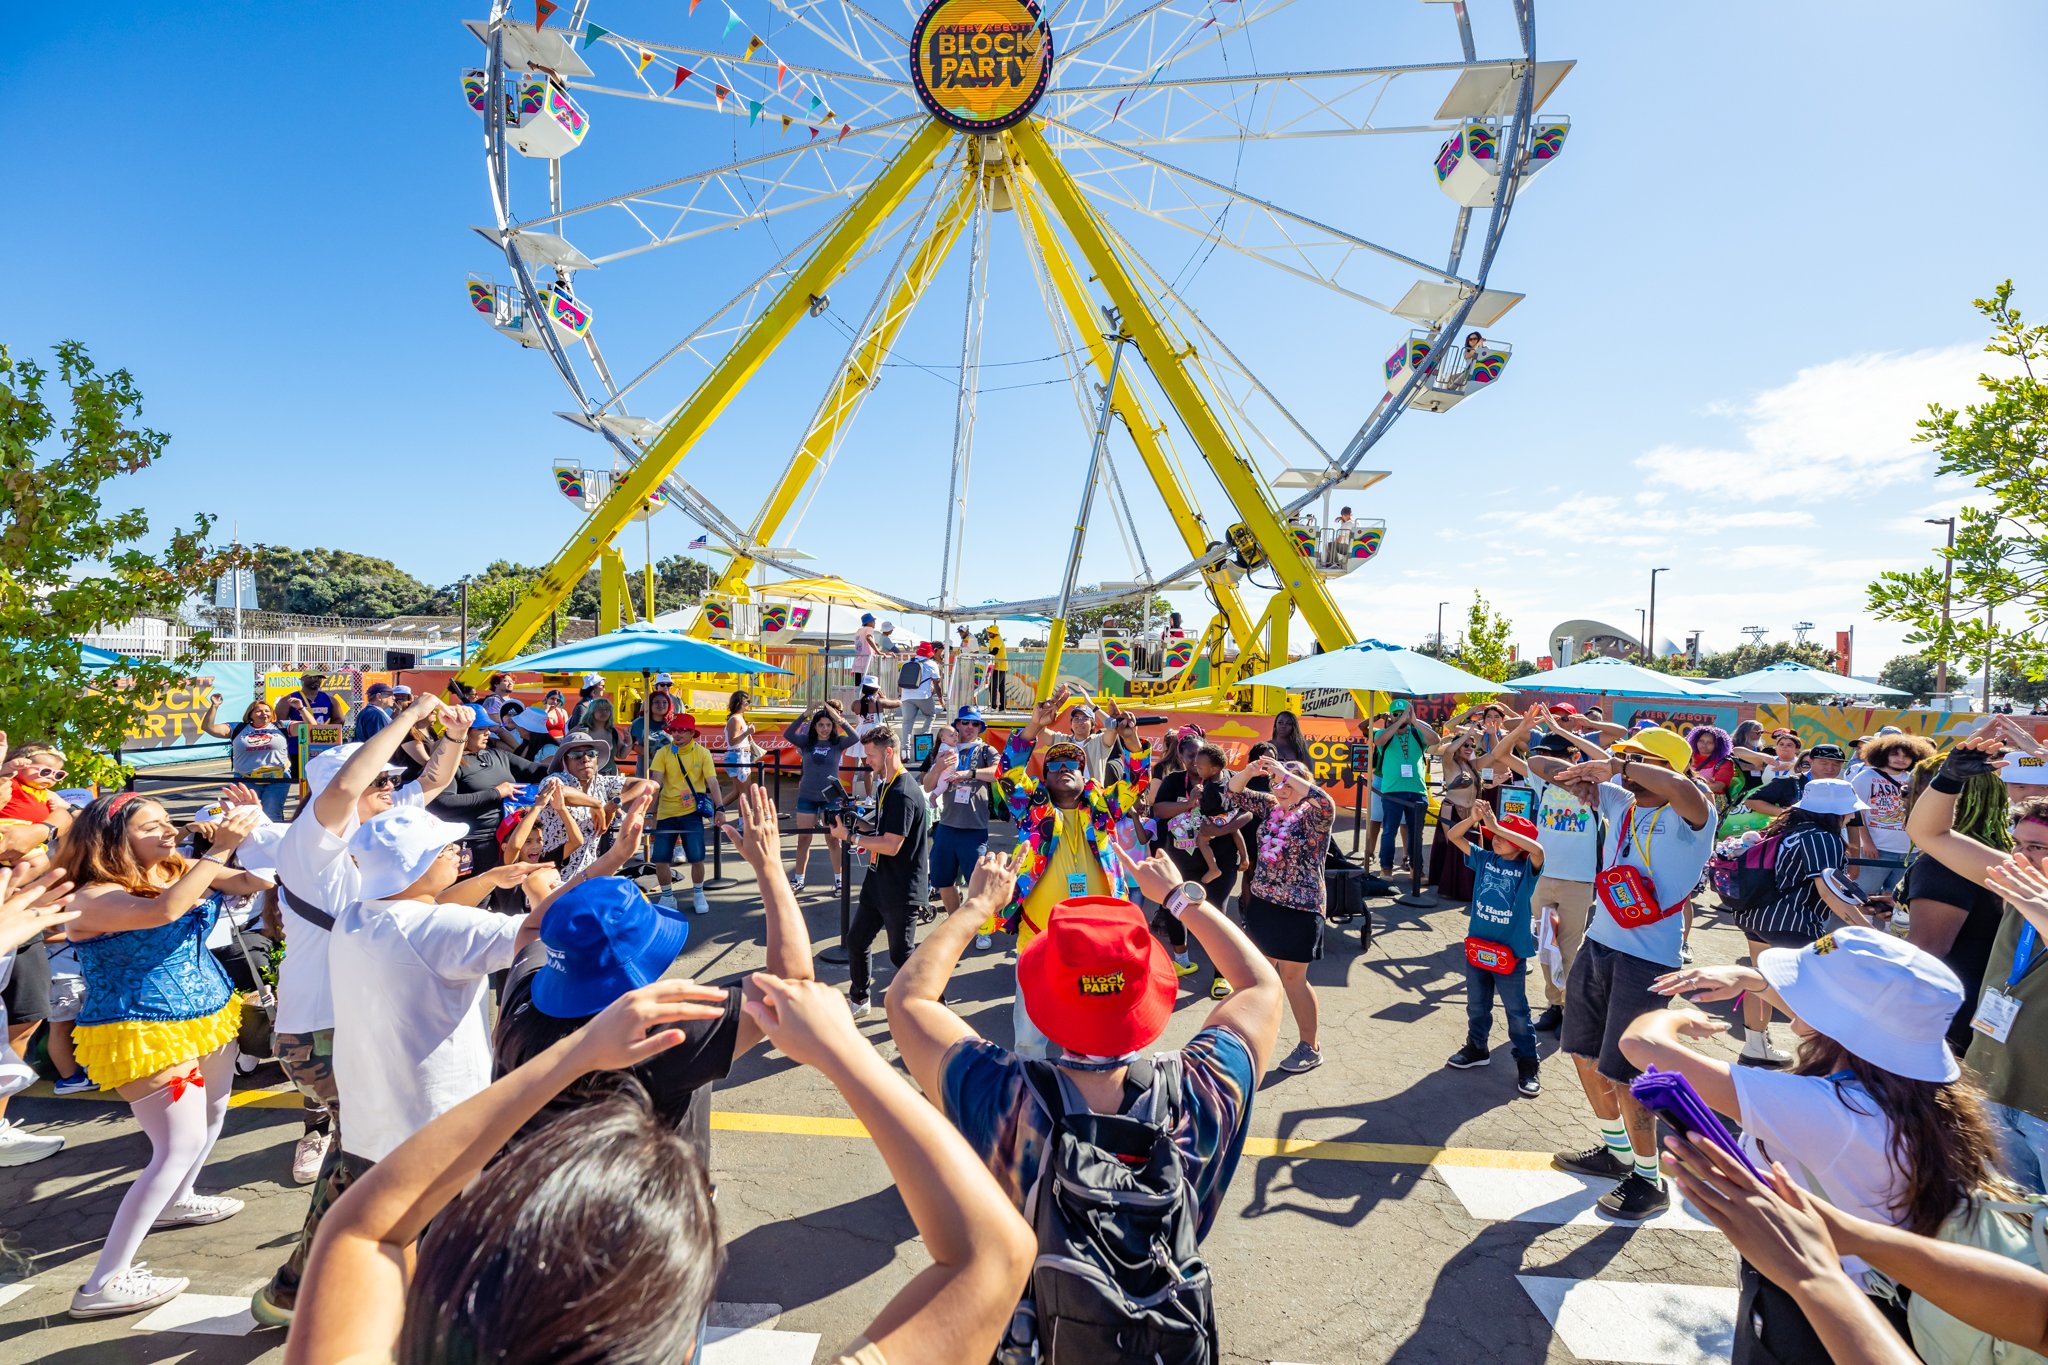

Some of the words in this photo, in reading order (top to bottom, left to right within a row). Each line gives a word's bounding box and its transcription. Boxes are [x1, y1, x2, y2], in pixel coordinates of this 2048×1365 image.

[939, 25, 947, 33] A
[951, 24, 982, 33] VERY
[986, 23, 1035, 33] ABBOTT
[938, 33, 1036, 55] BLOCK
[941, 56, 1033, 79] PARTY
[268, 676, 304, 689] MISSIN
[87, 686, 214, 712] OCK
[1301, 695, 1340, 713] NSUMED
[1416, 703, 1456, 720] RTY
[1645, 711, 1670, 720] VERY
[1673, 713, 1718, 722] ABBOTT
[1324, 734, 1369, 743] ABBOTT
[1490, 915, 1511, 925] Full
[1082, 973, 1126, 984] BLOCK
[1083, 983, 1126, 993] PARTY
